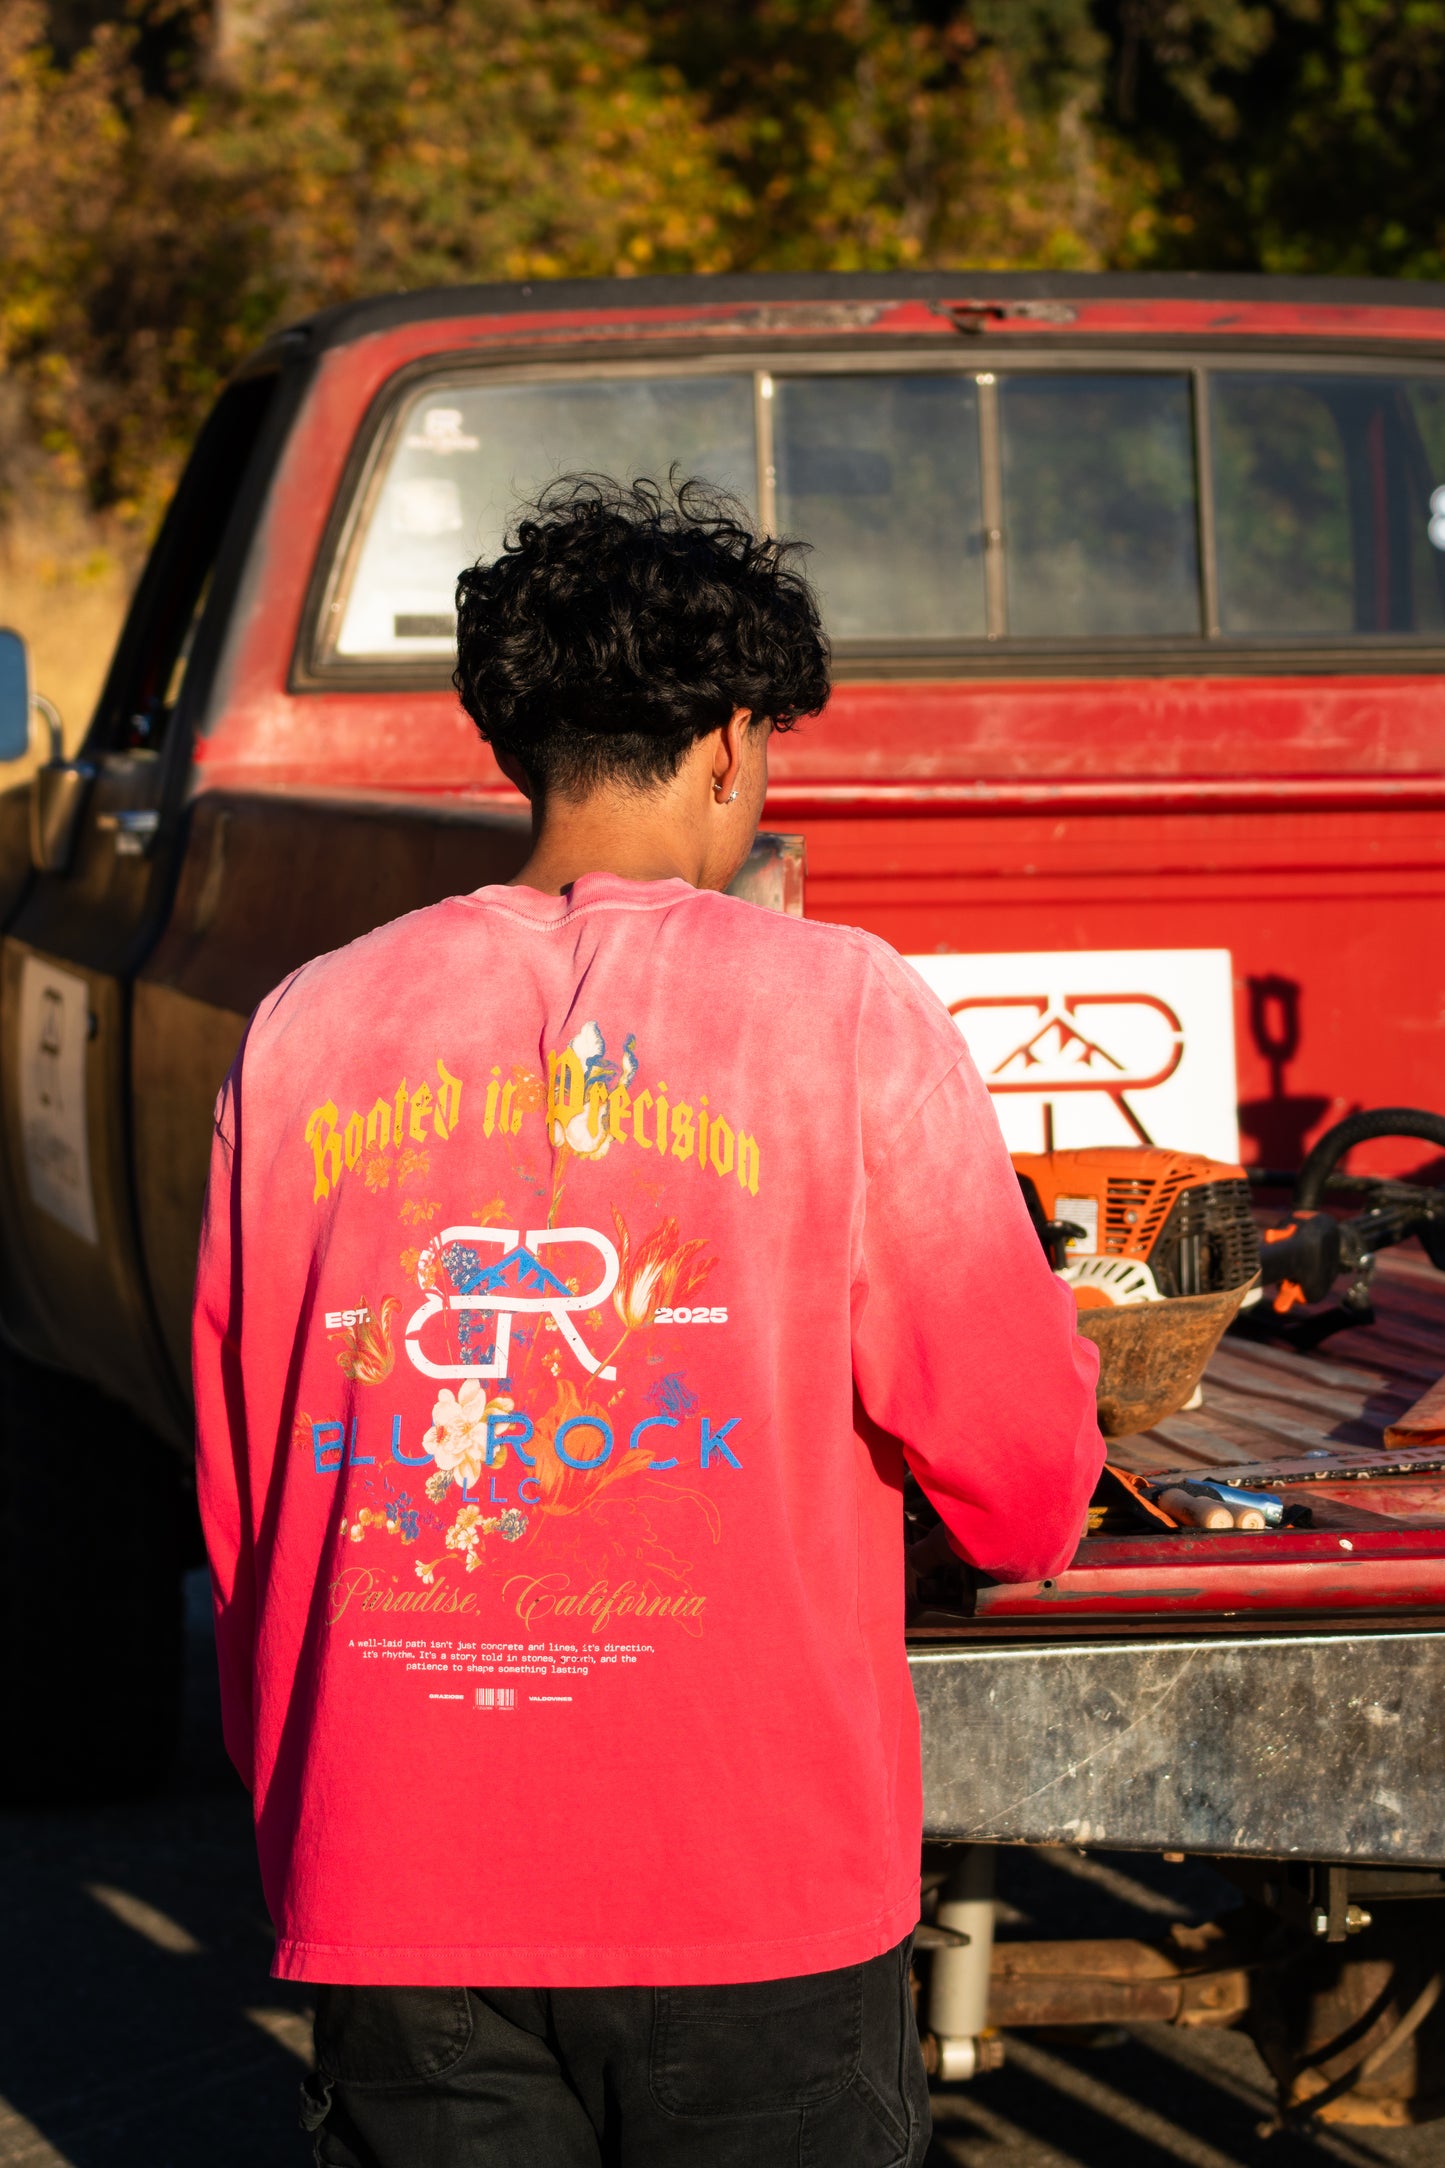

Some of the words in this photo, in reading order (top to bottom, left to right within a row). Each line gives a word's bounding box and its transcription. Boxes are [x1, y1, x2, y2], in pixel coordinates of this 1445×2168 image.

[305, 1059, 463, 1204] Rooted
[545, 1045, 760, 1197] Precision
[325, 1307, 371, 1329] EST.
[654, 1307, 728, 1324] 2025
[484, 1412, 744, 1470] ROCK
[461, 1477, 541, 1505] LLC
[325, 1566, 481, 1626] Paradise,
[501, 1573, 706, 1634] California
[348, 1639, 354, 1647] A
[358, 1639, 402, 1648] well-laid
[406, 1640, 426, 1650] path
[431, 1640, 453, 1649] isn't
[457, 1641, 476, 1651] just
[481, 1641, 524, 1650] concrete
[528, 1642, 545, 1650] and
[549, 1642, 578, 1653] lines,
[582, 1643, 600, 1651] it's
[604, 1643, 654, 1654] direction,
[363, 1651, 378, 1659] it's
[382, 1651, 415, 1661] rhythm.
[419, 1652, 436, 1660] It's
[450, 1652, 477, 1663] story
[481, 1653, 502, 1661] told
[507, 1653, 517, 1661] in
[521, 1653, 556, 1664] stones,
[600, 1655, 617, 1663] and
[621, 1655, 637, 1663] the
[406, 1662, 448, 1673] patience
[453, 1663, 463, 1671] to
[467, 1663, 494, 1674] shape
[498, 1664, 547, 1675] something
[551, 1665, 588, 1675] lasting
